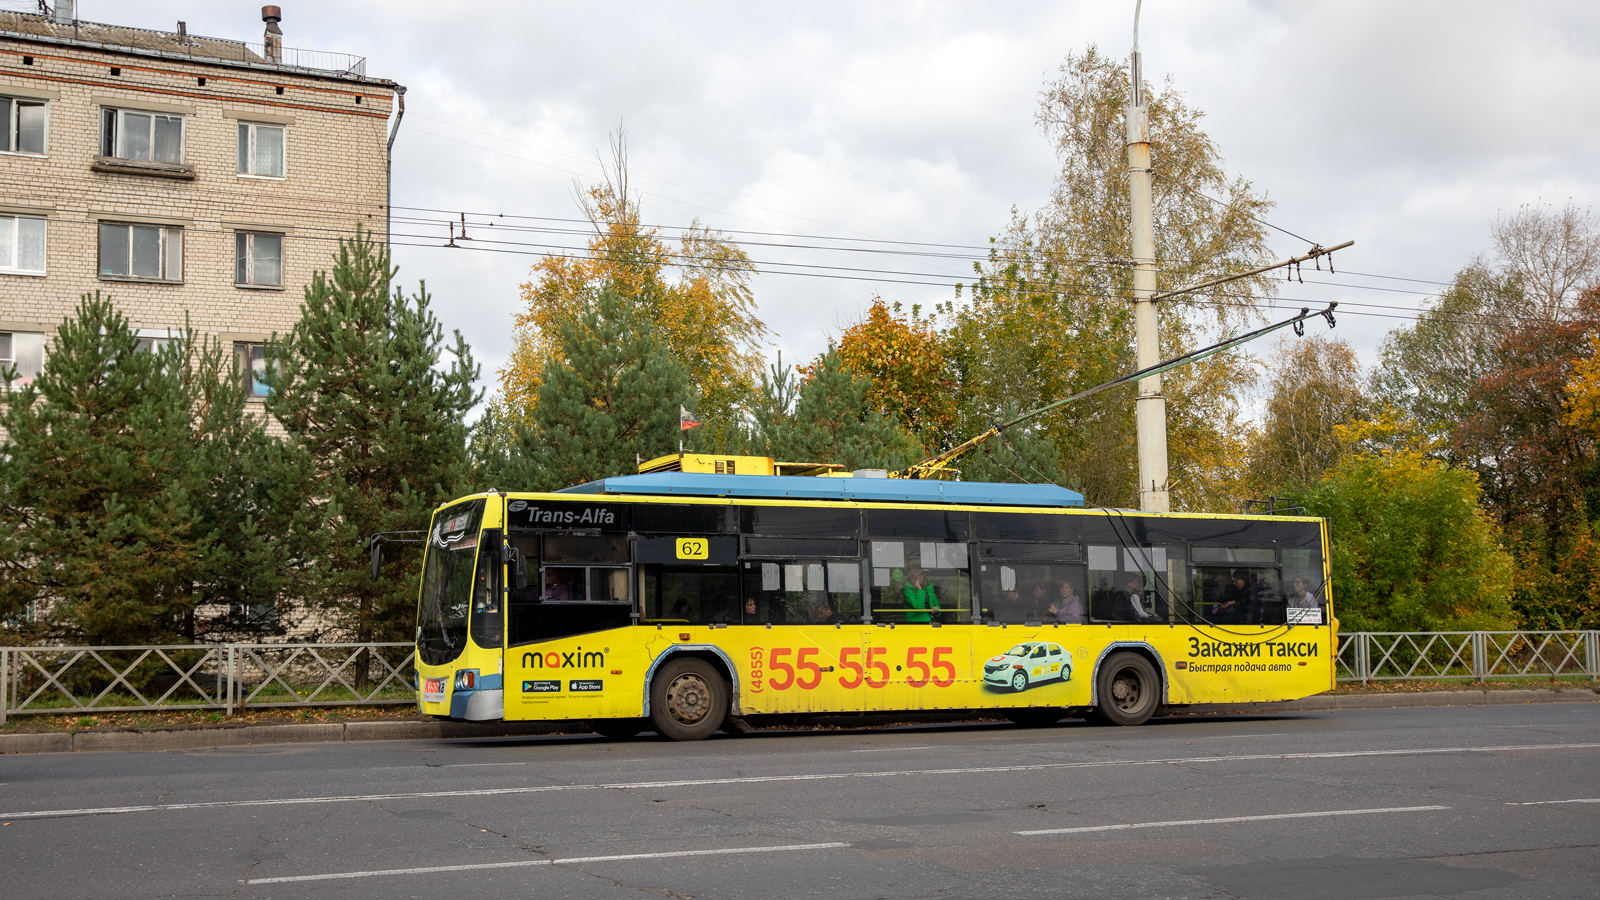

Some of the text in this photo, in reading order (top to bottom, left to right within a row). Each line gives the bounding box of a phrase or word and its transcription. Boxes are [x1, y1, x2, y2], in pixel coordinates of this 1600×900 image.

[527, 506, 614, 524] Trans-Alfa
[682, 542, 703, 556] 62
[1188, 636, 1318, 658] Закажи такси
[750, 646, 764, 694] (4855)
[1189, 662, 1292, 674] Быстрая подача авто
